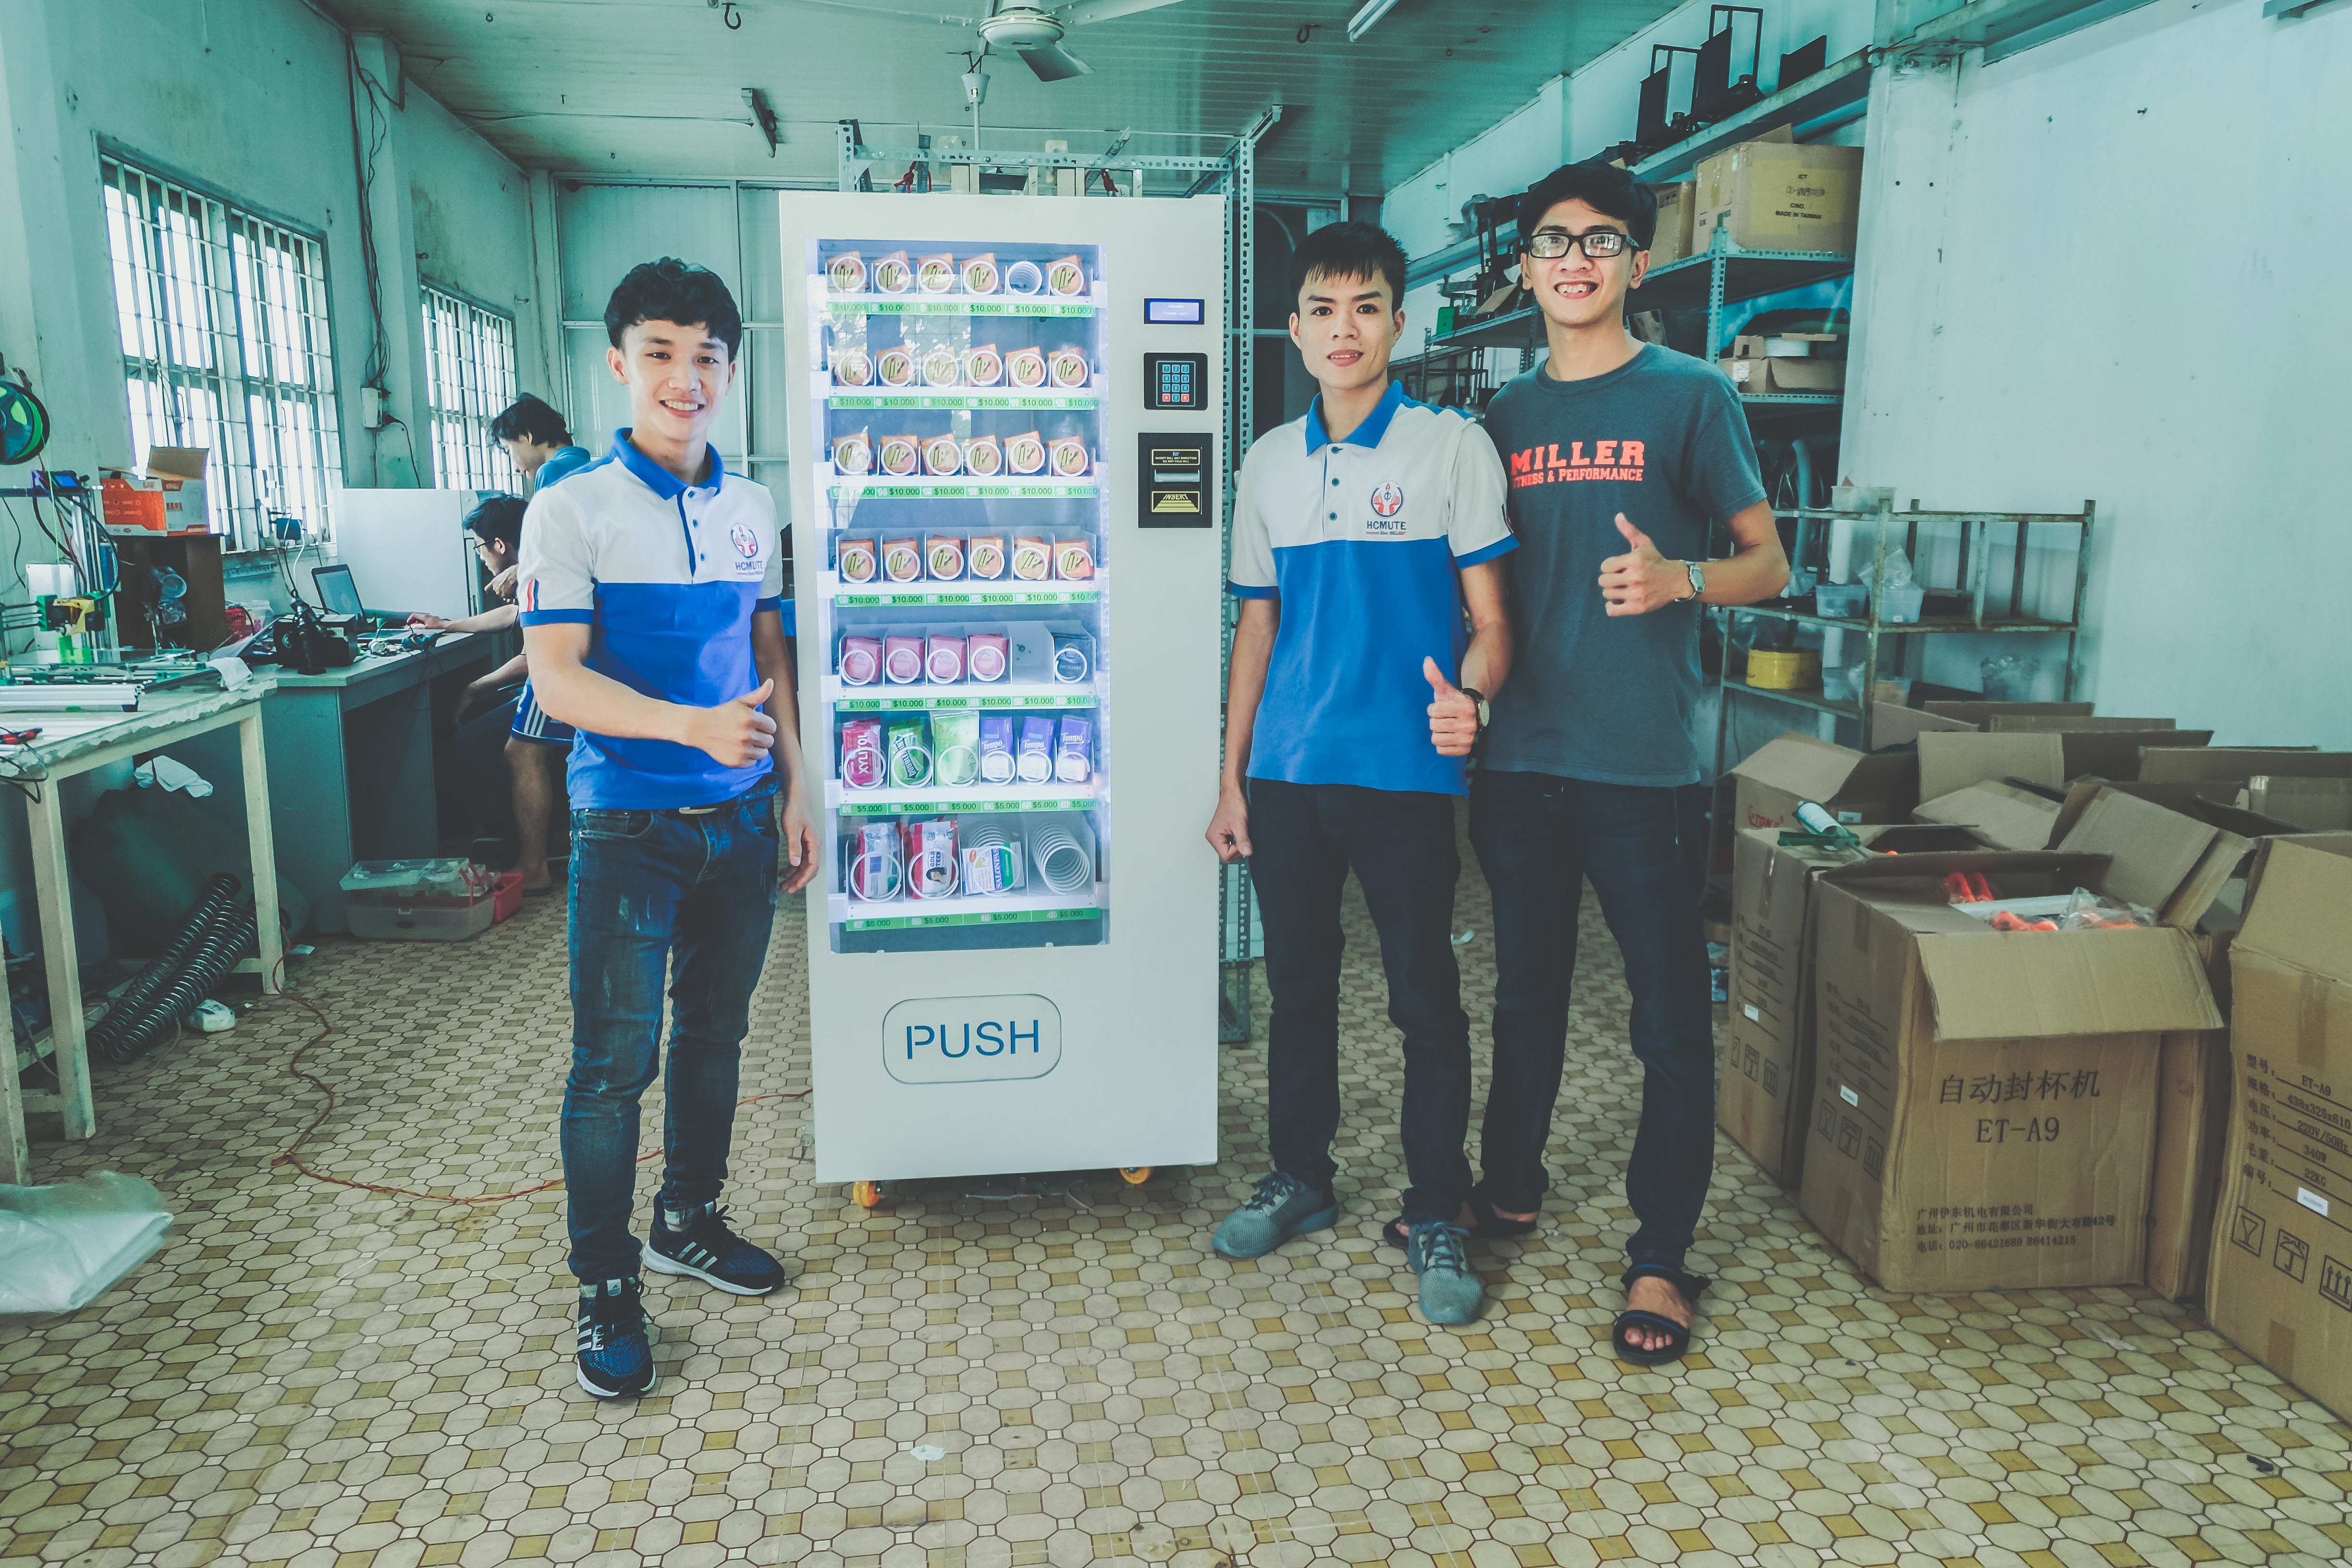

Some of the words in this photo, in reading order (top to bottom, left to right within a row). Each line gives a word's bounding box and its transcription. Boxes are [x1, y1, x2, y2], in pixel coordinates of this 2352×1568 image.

[879, 303, 910, 311] $10.000
[928, 304, 958, 312] $10.000
[1061, 306, 1091, 314] $10.000
[832, 397, 838, 406] 7
[1022, 398, 1053, 406] $10.000
[1068, 399, 1098, 407] $10.000
[1510, 440, 1645, 476] MILLER
[1547, 470, 1555, 483] &
[1558, 467, 1644, 482] PERFORMANCE
[1367, 520, 1407, 530] HCMUTE
[969, 698, 980, 706] 28
[1061, 732, 1084, 743] Tempo
[981, 740, 1003, 750] Tempo
[1022, 739, 1044, 749] Tempo
[993, 847, 1003, 888] SALONPAS
[1060, 909, 1084, 918] $5.000
[906, 1019, 1039, 1059] PUSH
[1939, 1069, 2101, 1104] 自动封杯机
[2302, 1075, 2332, 1097] ET-A9
[1976, 1116, 2060, 1143] ET-A9
[2305, 1167, 2327, 1188] 22KG
